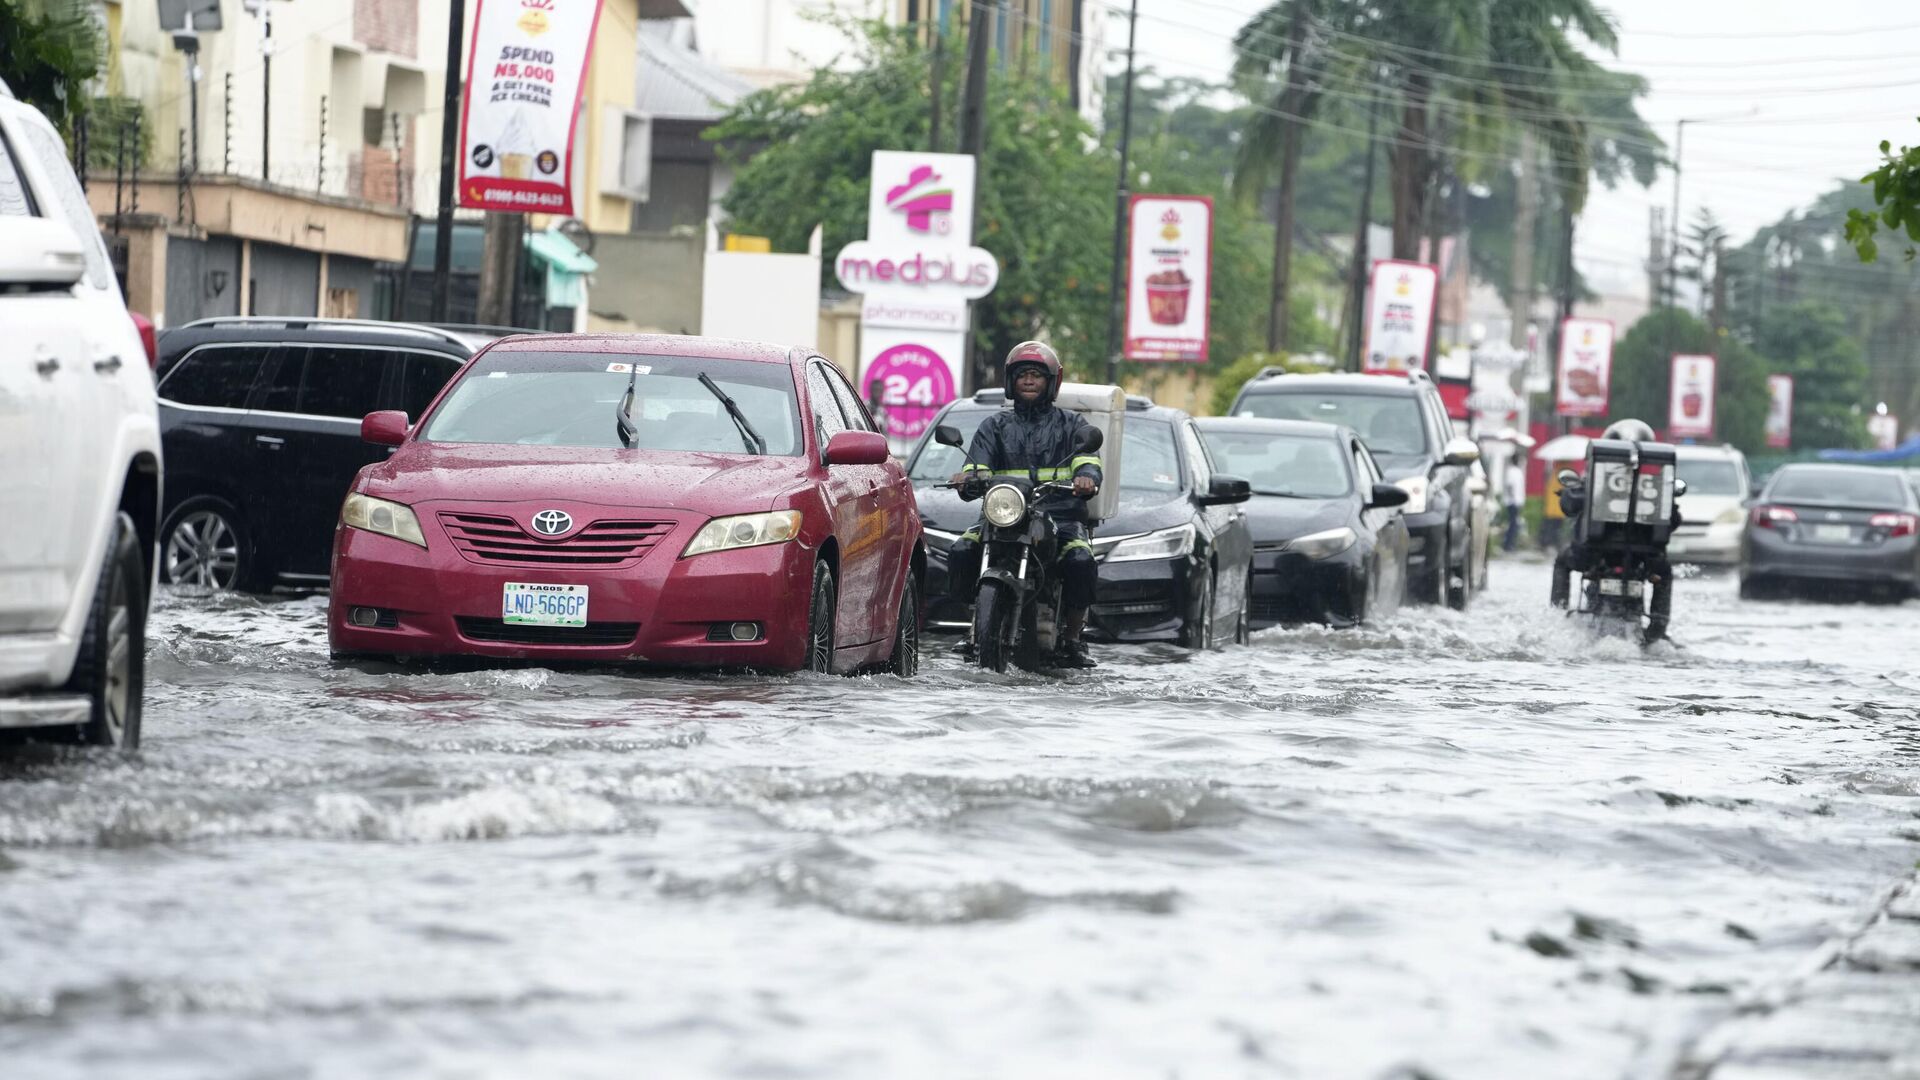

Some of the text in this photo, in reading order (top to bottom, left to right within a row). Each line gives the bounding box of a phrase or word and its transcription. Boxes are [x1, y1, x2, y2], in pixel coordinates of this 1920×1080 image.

[500, 46, 554, 64] SPEND
[503, 81, 523, 90] GET
[526, 83, 552, 96] FREE
[490, 92, 552, 107] ICE CREAM
[842, 252, 989, 288] medplus
[866, 304, 958, 323] pharmacy
[889, 351, 931, 368] OPEN
[882, 374, 934, 406] 24
